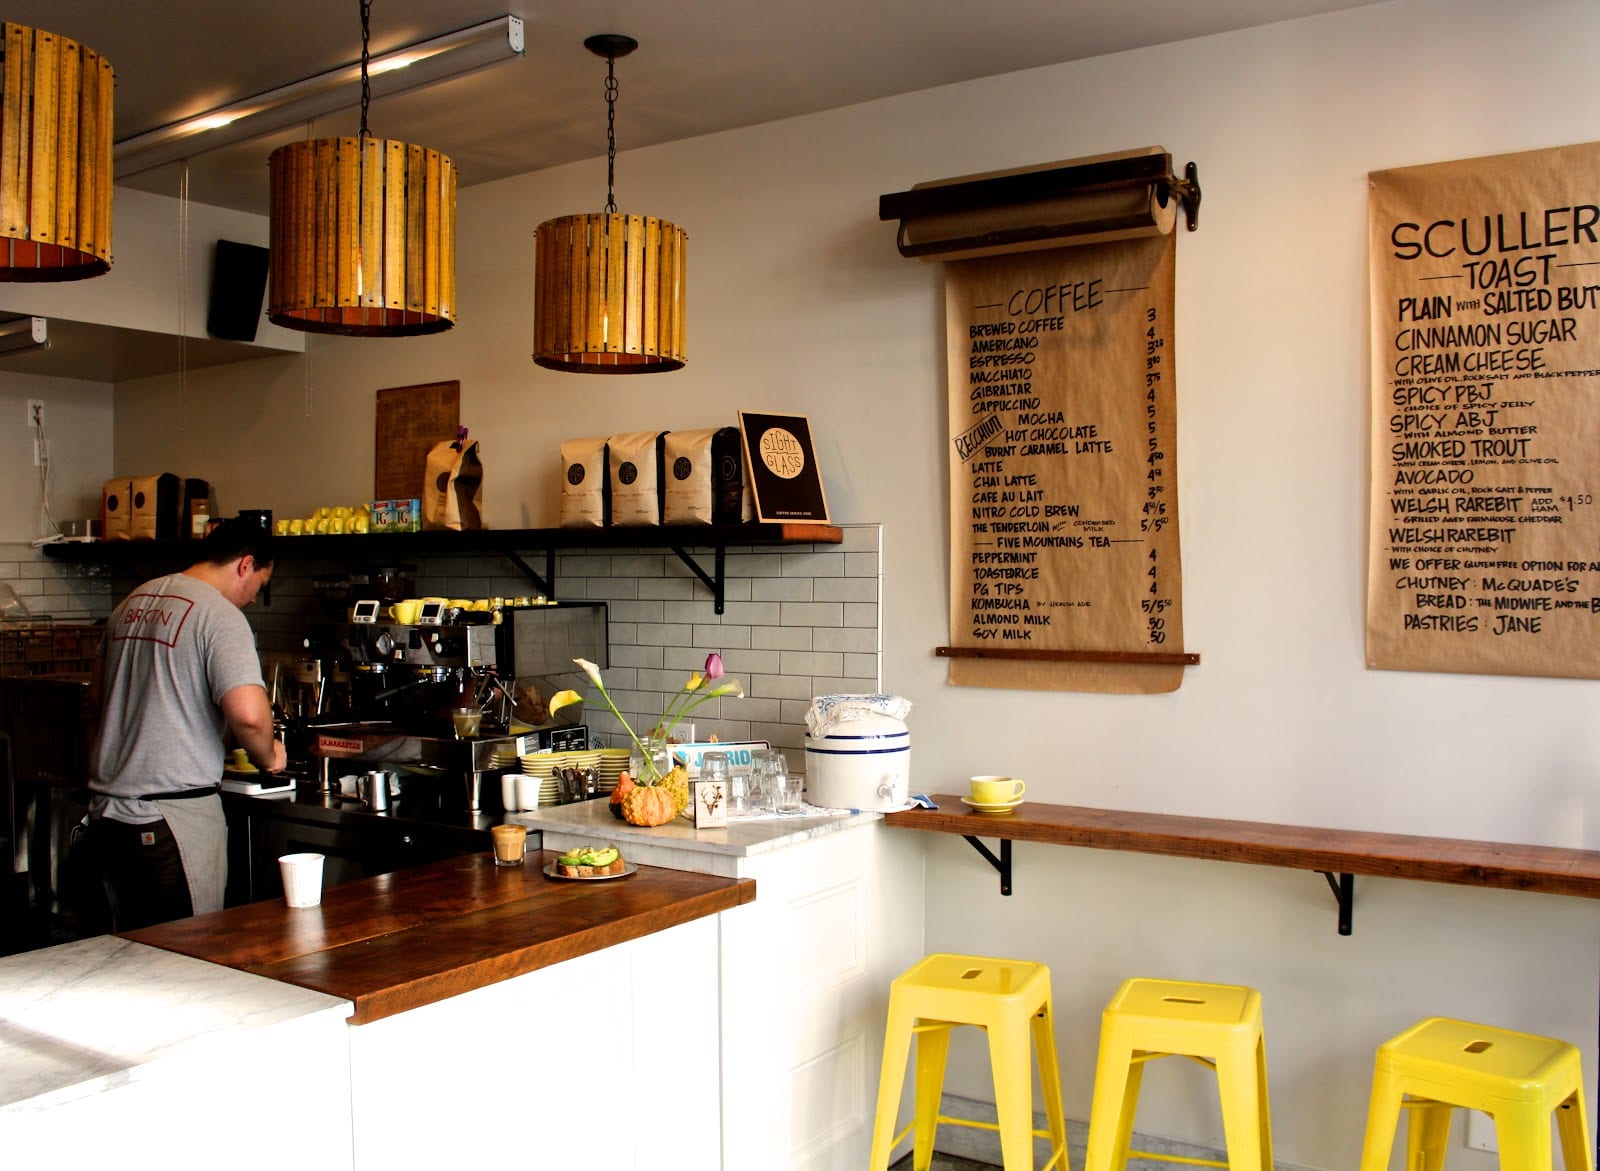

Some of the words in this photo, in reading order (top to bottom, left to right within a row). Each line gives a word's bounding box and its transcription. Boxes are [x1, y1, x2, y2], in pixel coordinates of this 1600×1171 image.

[1391, 204, 1600, 260] SCULLER
[1462, 254, 1557, 290] TOAST
[1008, 279, 1103, 316] COFFEE
[1398, 295, 1452, 322] PLAIN
[1456, 299, 1481, 312] WITH
[1483, 288, 1552, 316] SALTED
[970, 322, 1015, 338] BREWED
[1018, 317, 1064, 333] COFFEE
[1147, 308, 1156, 322] 3
[971, 337, 1038, 353] AMERICANO
[1146, 327, 1156, 339] 4
[1395, 323, 1501, 351] CINNAMON
[1506, 317, 1577, 346] SUGAR
[970, 352, 1035, 368] ESPRESSO
[1395, 352, 1460, 377] CREAM
[1463, 347, 1546, 373] CHEESE
[970, 368, 1032, 384] MACCHIATO
[1395, 378, 1414, 386] WITH
[1416, 376, 1442, 385] OLIVE
[1534, 371, 1562, 379] BLACK
[970, 384, 1032, 400] GIBRALTAR
[1393, 385, 1452, 405] SPICY
[1455, 382, 1494, 403] PBJ
[972, 397, 1040, 414] CAPPUCCINO
[1147, 389, 1155, 401] 4
[1404, 404, 1442, 412] CHOICE
[1462, 402, 1497, 410] SPICY
[1018, 411, 1064, 426] MOCHA
[1147, 405, 1156, 418] 5
[1390, 413, 1448, 433] SPICY
[1455, 410, 1499, 429] ABJ
[1005, 429, 1028, 444] HOT
[1030, 425, 1097, 441] CHOCOLATE
[1148, 422, 1156, 435] 5
[1434, 429, 1484, 438] ALMOND
[1489, 426, 1538, 435] BUTTER
[763, 430, 798, 452] SIGHT
[985, 446, 1017, 458] BURNT
[1020, 442, 1068, 456] CARAMEL
[1075, 440, 1113, 454] LATTE
[1149, 438, 1158, 451] 5
[1392, 440, 1465, 461] SMOKED
[1470, 438, 1531, 458] TROUT
[766, 454, 801, 475] GLASS
[972, 460, 1003, 474] LATTE
[973, 476, 1000, 489] CHAI
[1004, 474, 1037, 487] LATTE
[1395, 469, 1474, 485] AVOCADO
[972, 491, 998, 504] CAFE
[1001, 491, 1015, 503] AU
[1020, 490, 1044, 502] LAIT
[972, 507, 1006, 519] NITRO
[1009, 506, 1040, 518] COLD
[1045, 505, 1079, 517] BREW
[1391, 498, 1450, 514] WELSH
[1455, 497, 1523, 513] RAREBIT
[972, 523, 988, 533] THE
[990, 521, 1049, 534] TENDERLOIN
[1389, 528, 1444, 543] WELSH
[1447, 528, 1516, 543] RAREBIT
[997, 536, 1021, 548] FIVE
[1022, 536, 1084, 549] MOUNTAINS
[1089, 536, 1111, 548] TEA
[972, 552, 1038, 564] PEPPERMINT
[1148, 549, 1156, 561] 4
[1148, 566, 1156, 579] 4
[1389, 558, 1411, 571] WE
[1415, 559, 1462, 571] OFFER
[1464, 561, 1496, 569] GLUTEN
[1497, 561, 1518, 569] FREE
[1521, 560, 1563, 571] OPTION
[1567, 561, 1587, 572] FOR
[973, 582, 989, 595] PG
[994, 582, 1024, 595] TIPS
[1149, 582, 1157, 595] 4
[971, 598, 1030, 610] KOMBUCHA
[1475, 598, 1492, 607] THE
[1494, 597, 1553, 611] MIDWIFE
[1555, 600, 1573, 609] AND
[1573, 601, 1590, 609] THE
[973, 614, 1020, 625] ALMOND
[1024, 614, 1051, 626] MILK
[1493, 614, 1542, 636] JANE
[973, 628, 998, 640] SOY
[1002, 629, 1032, 640] MILK
